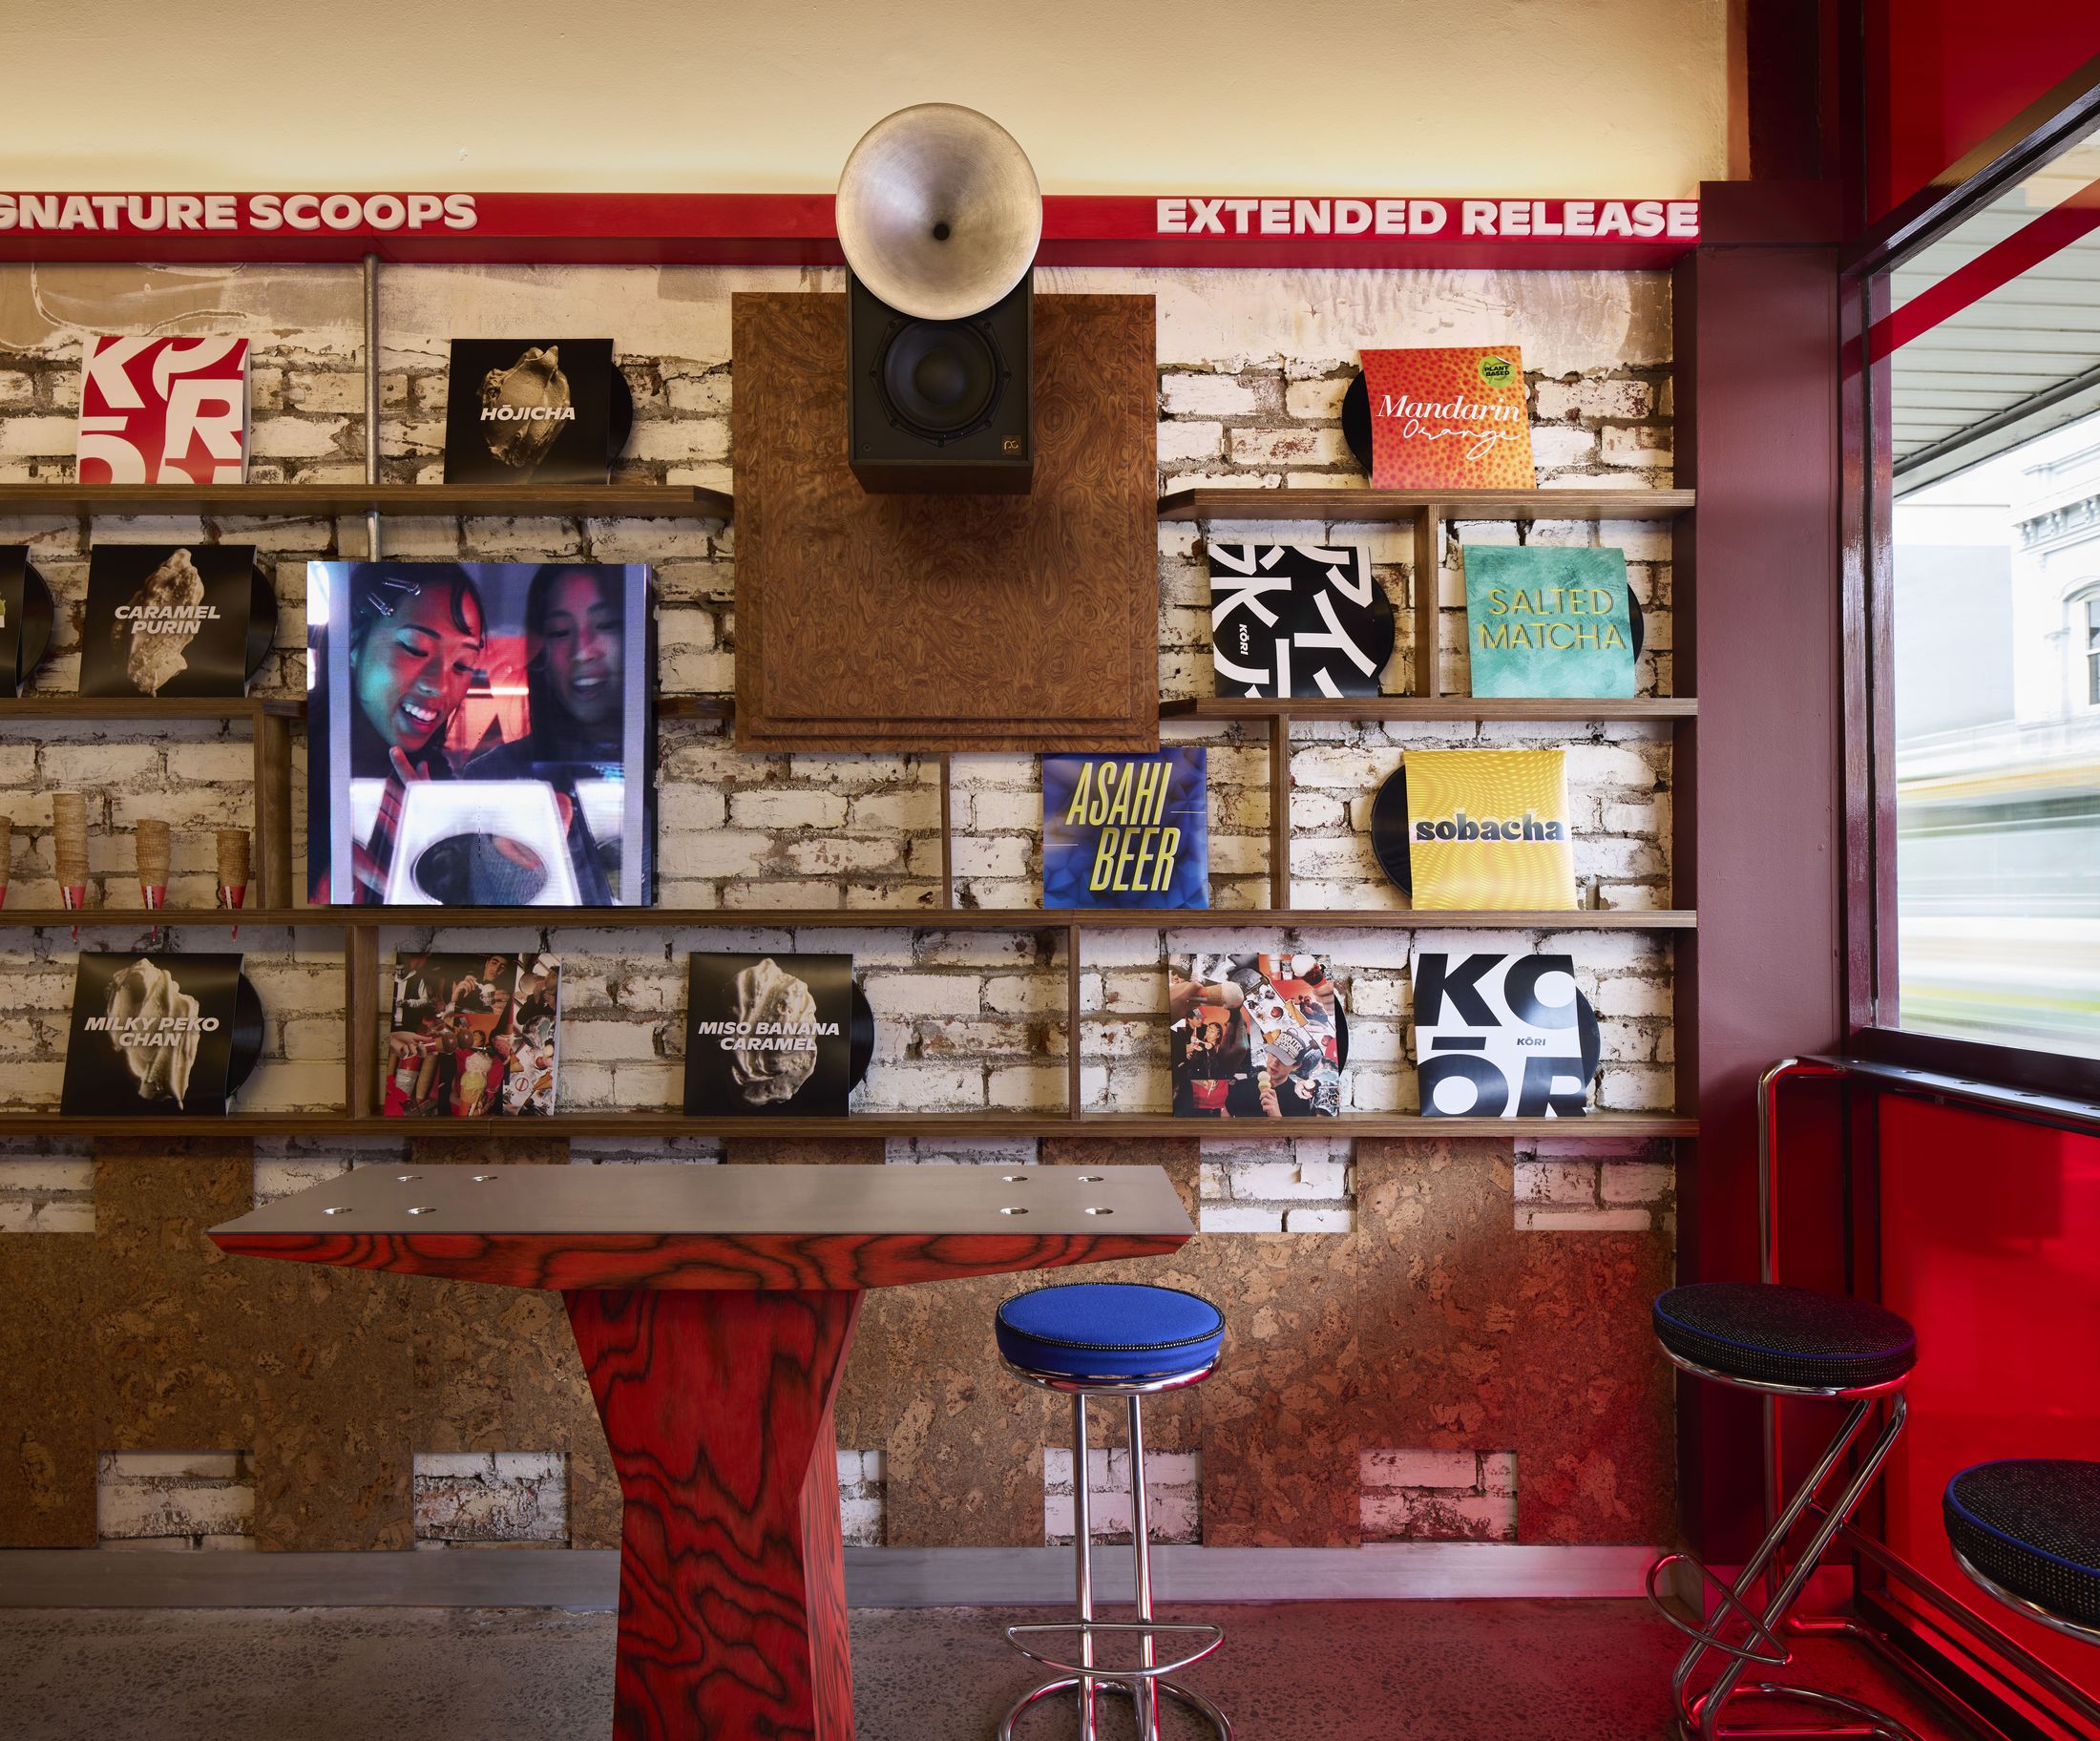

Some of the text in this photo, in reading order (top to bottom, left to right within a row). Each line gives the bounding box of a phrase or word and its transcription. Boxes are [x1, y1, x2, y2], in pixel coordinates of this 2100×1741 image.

[248, 194, 477, 231] SCOOPS
[1156, 199, 1699, 237] EXTENDED RELEASE
[480, 404, 576, 421] HŌJICHA
[1376, 394, 1521, 422] Mandarin
[1403, 418, 1522, 460] Orange
[115, 605, 221, 619] CARAMEL
[1488, 588, 1614, 616] SALTED
[131, 620, 201, 635] PURIN
[1480, 622, 1627, 651] MATCHA
[1064, 761, 1173, 826] ASAHI
[1416, 812, 1564, 841] sobacha
[1089, 827, 1181, 891] BEER
[84, 1017, 220, 1032] MILKY PEKO
[698, 1021, 840, 1036] MISO BANANA
[118, 1032, 181, 1047] CHAN
[720, 1037, 817, 1051] CARAMEL
[1517, 1036, 1546, 1046] KŌRI
